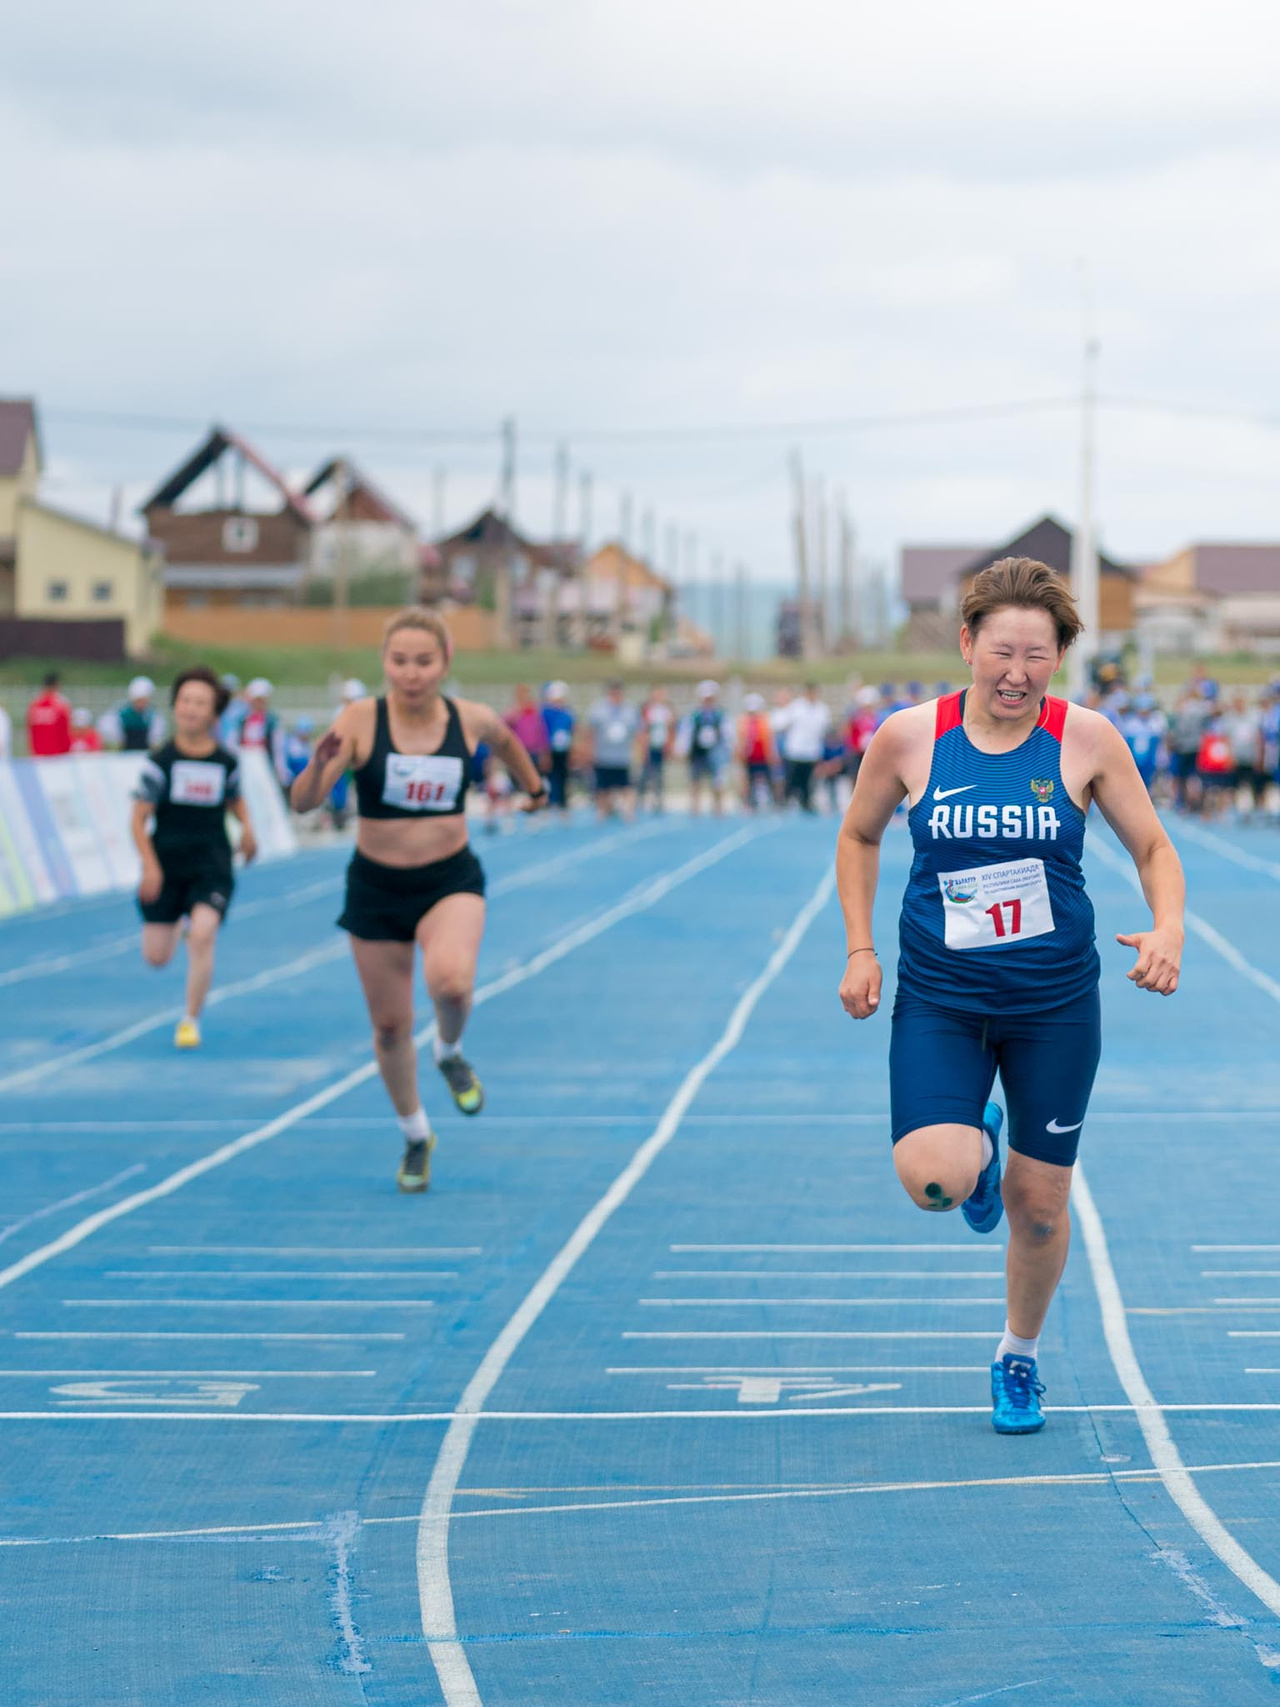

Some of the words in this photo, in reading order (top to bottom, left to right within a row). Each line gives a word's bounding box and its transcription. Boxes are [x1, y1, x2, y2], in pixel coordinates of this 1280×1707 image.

[406, 781, 445, 804] 161
[928, 805, 1061, 841] RUSSIA
[993, 863, 1040, 879] СПАРТАКИАДА
[985, 898, 1022, 938] 17
